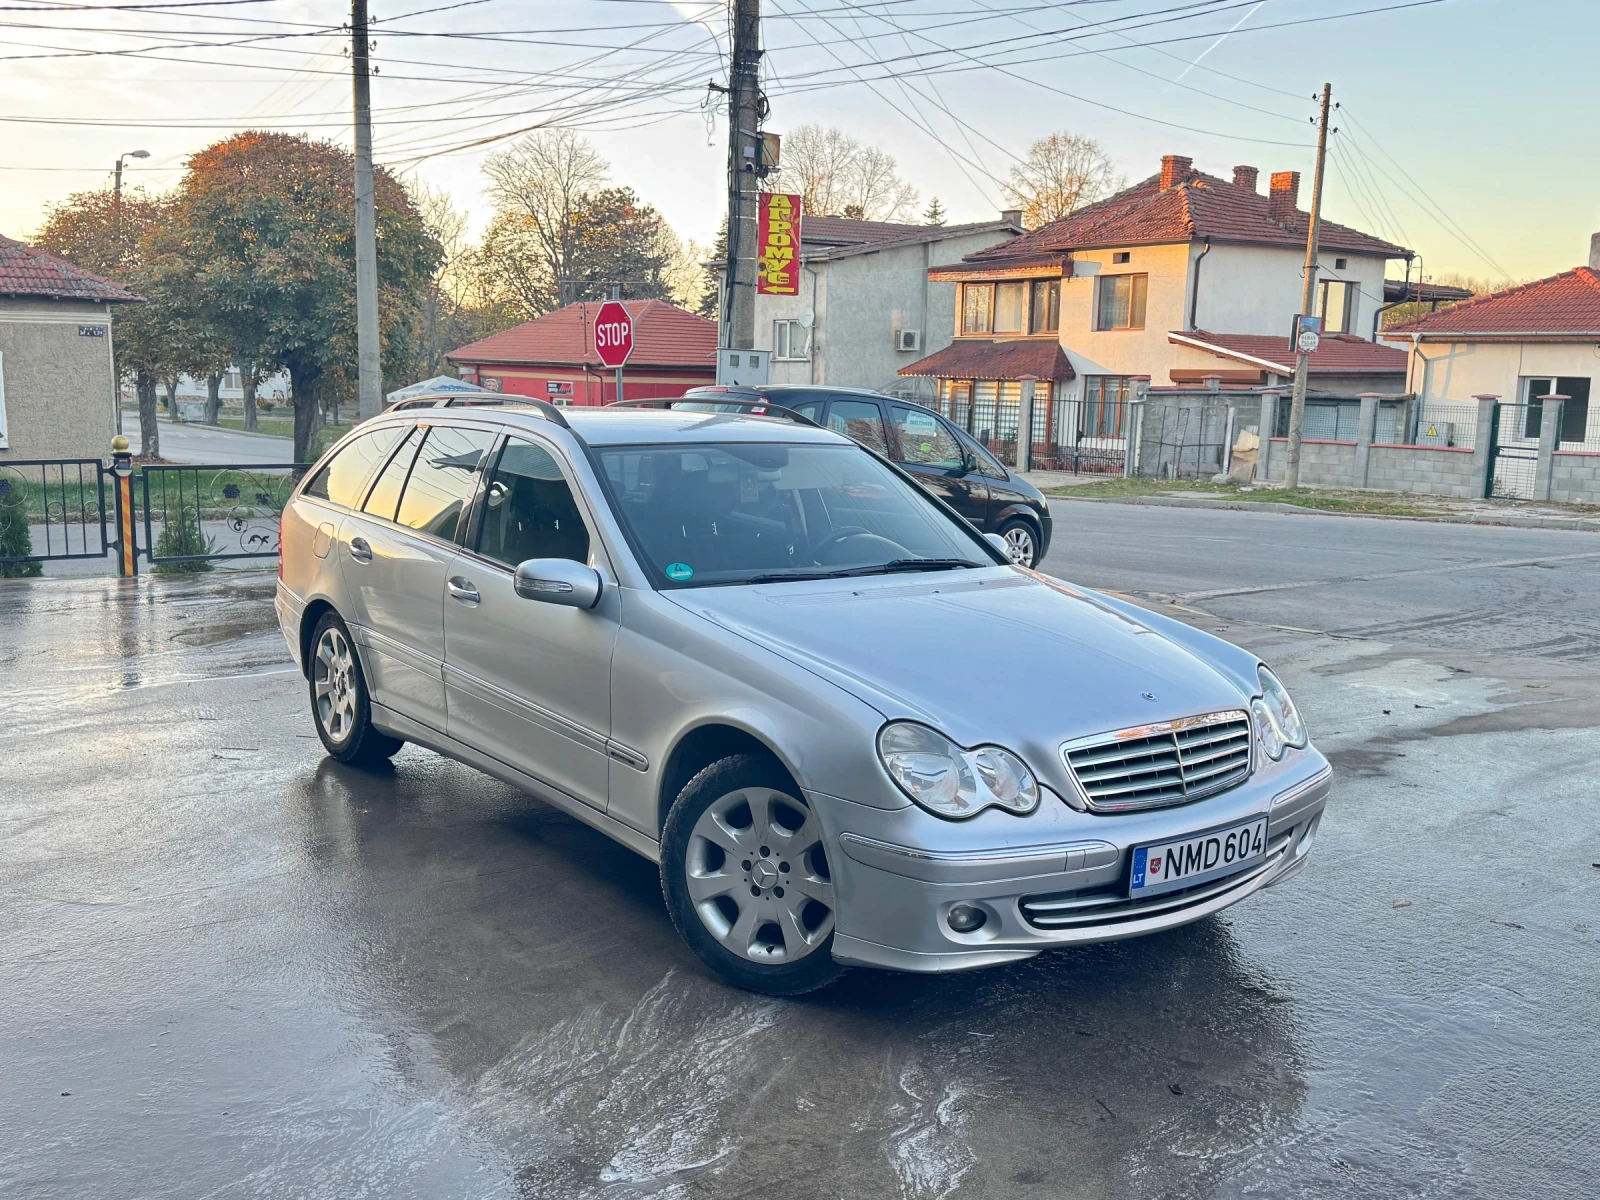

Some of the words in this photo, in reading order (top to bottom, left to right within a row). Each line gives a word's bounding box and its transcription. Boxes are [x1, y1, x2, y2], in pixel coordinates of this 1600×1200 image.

[597, 322, 629, 347] STOP
[675, 563, 683, 572] 4
[1133, 873, 1144, 884] LT
